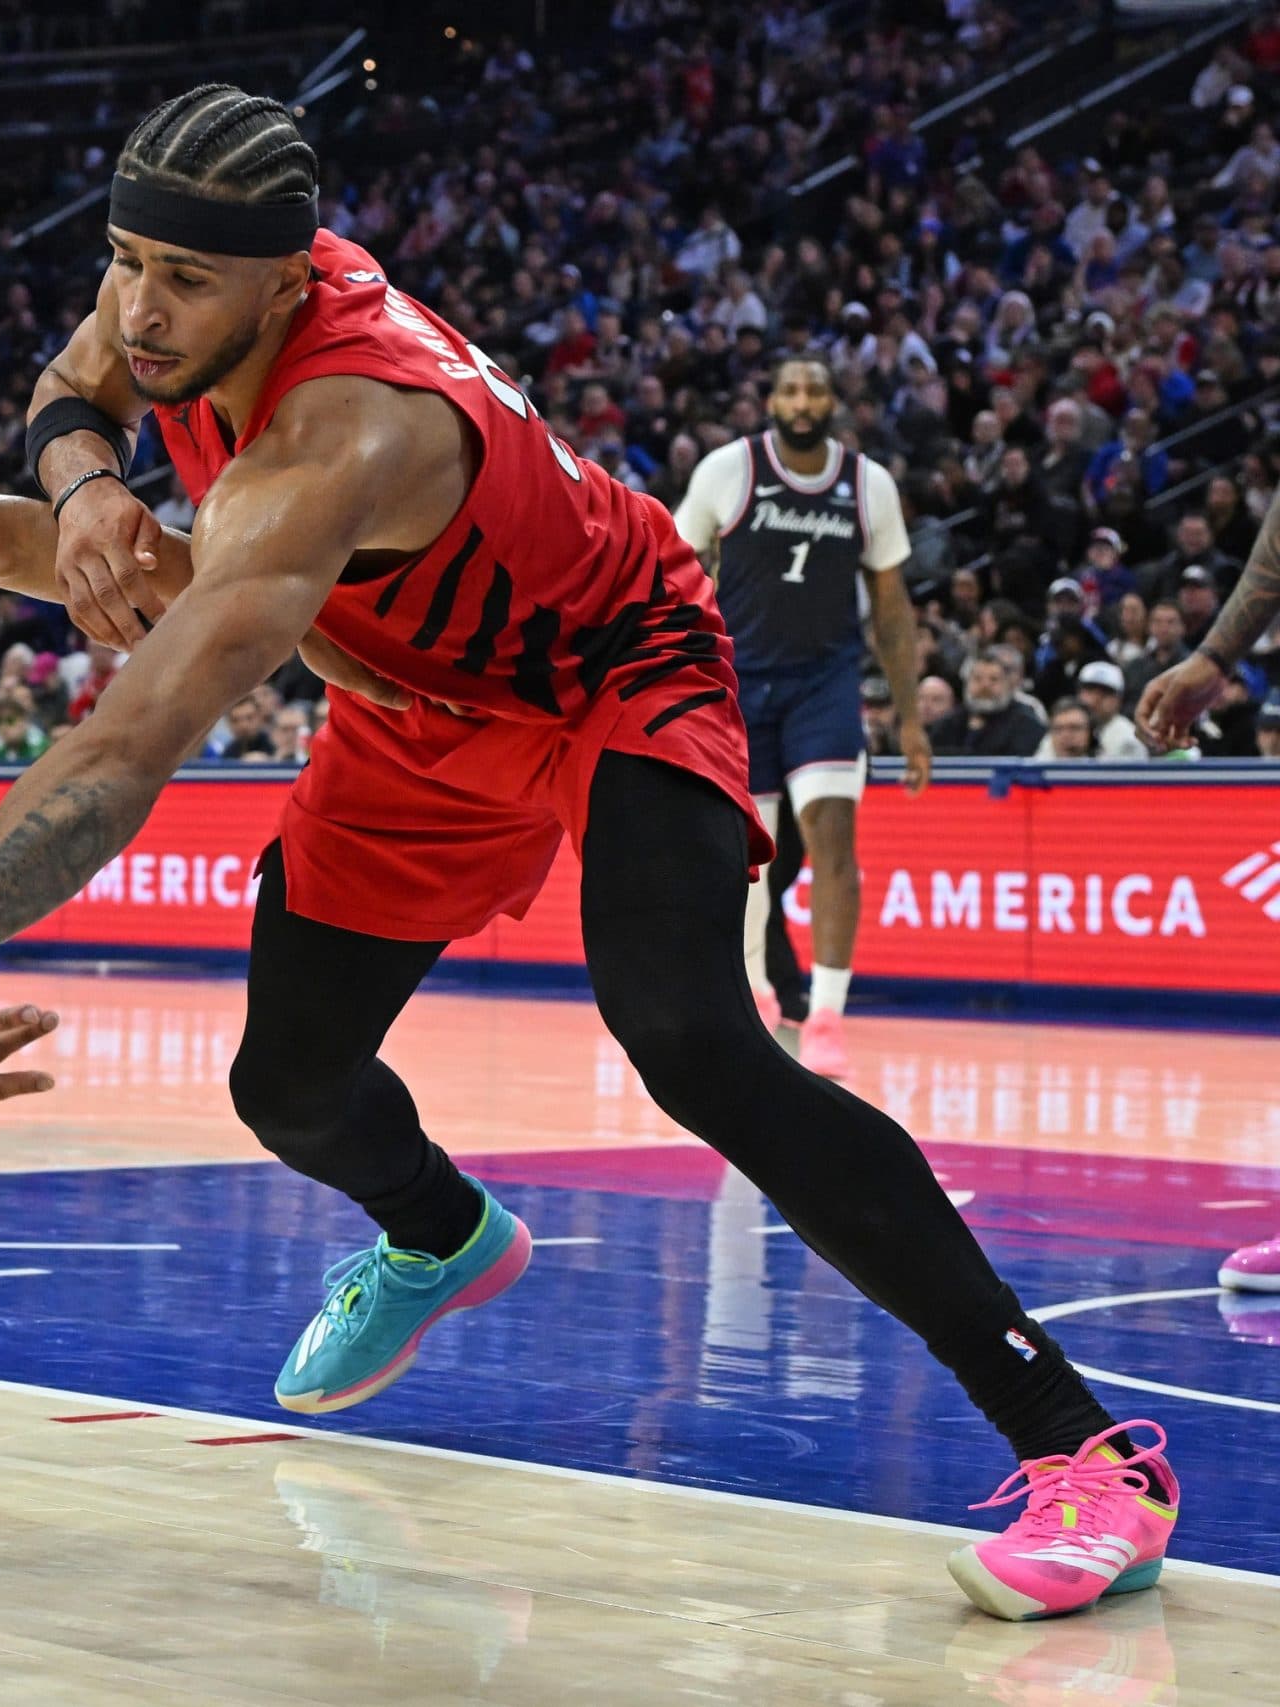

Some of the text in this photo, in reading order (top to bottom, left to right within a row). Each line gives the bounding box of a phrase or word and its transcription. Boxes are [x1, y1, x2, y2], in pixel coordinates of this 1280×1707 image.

[750, 501, 855, 541] Philadelphia
[781, 541, 810, 583] 1
[72, 852, 262, 908] MERIC
[880, 869, 1207, 938] AMERICA
